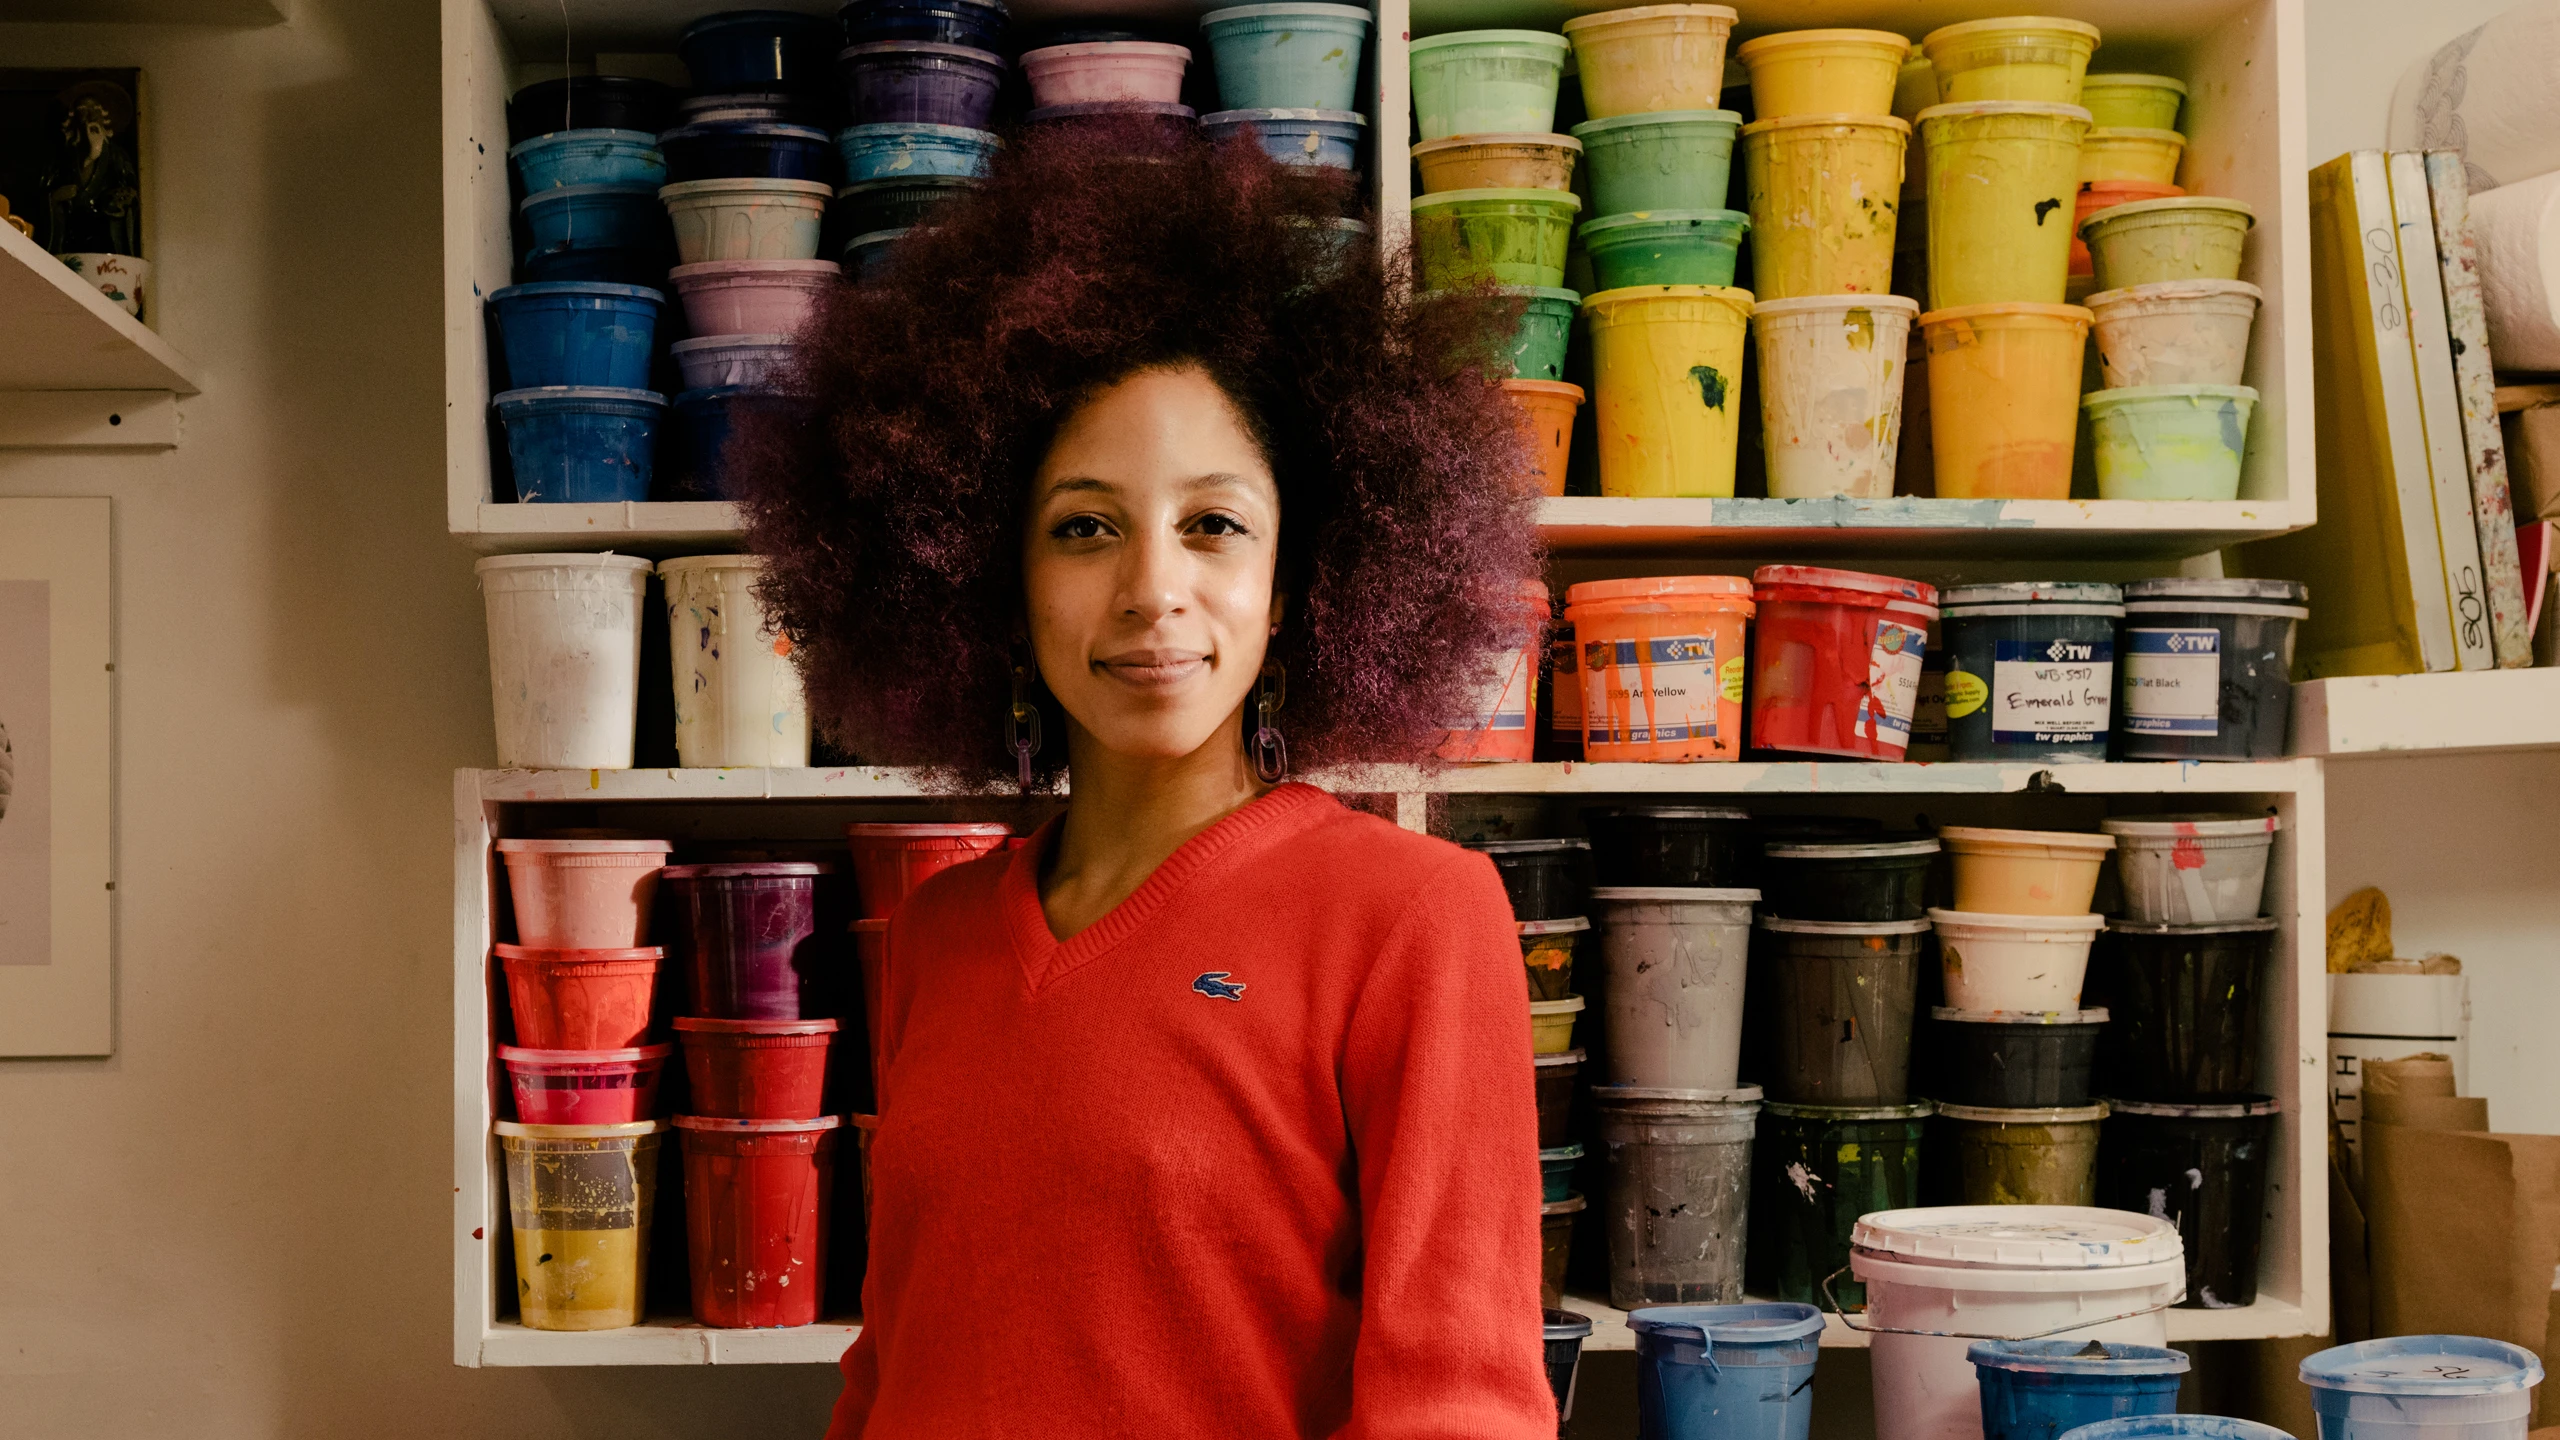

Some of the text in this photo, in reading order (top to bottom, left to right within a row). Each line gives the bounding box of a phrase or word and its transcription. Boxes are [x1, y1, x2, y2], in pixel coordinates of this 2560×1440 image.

[2453, 565, 2484, 649] 305
[1683, 642, 1712, 657] TW
[2184, 635, 2214, 651] TW
[2065, 645, 2092, 660] TW
[2138, 677, 2153, 688] lat
[2156, 678, 2181, 688] Black
[1607, 686, 1687, 699] 5595 Ar Yellow
[2006, 690, 2075, 710] Emerald
[2135, 719, 2171, 729] graphics
[2035, 732, 2094, 743] tw graphics
[2334, 1054, 2357, 1143] ITH
